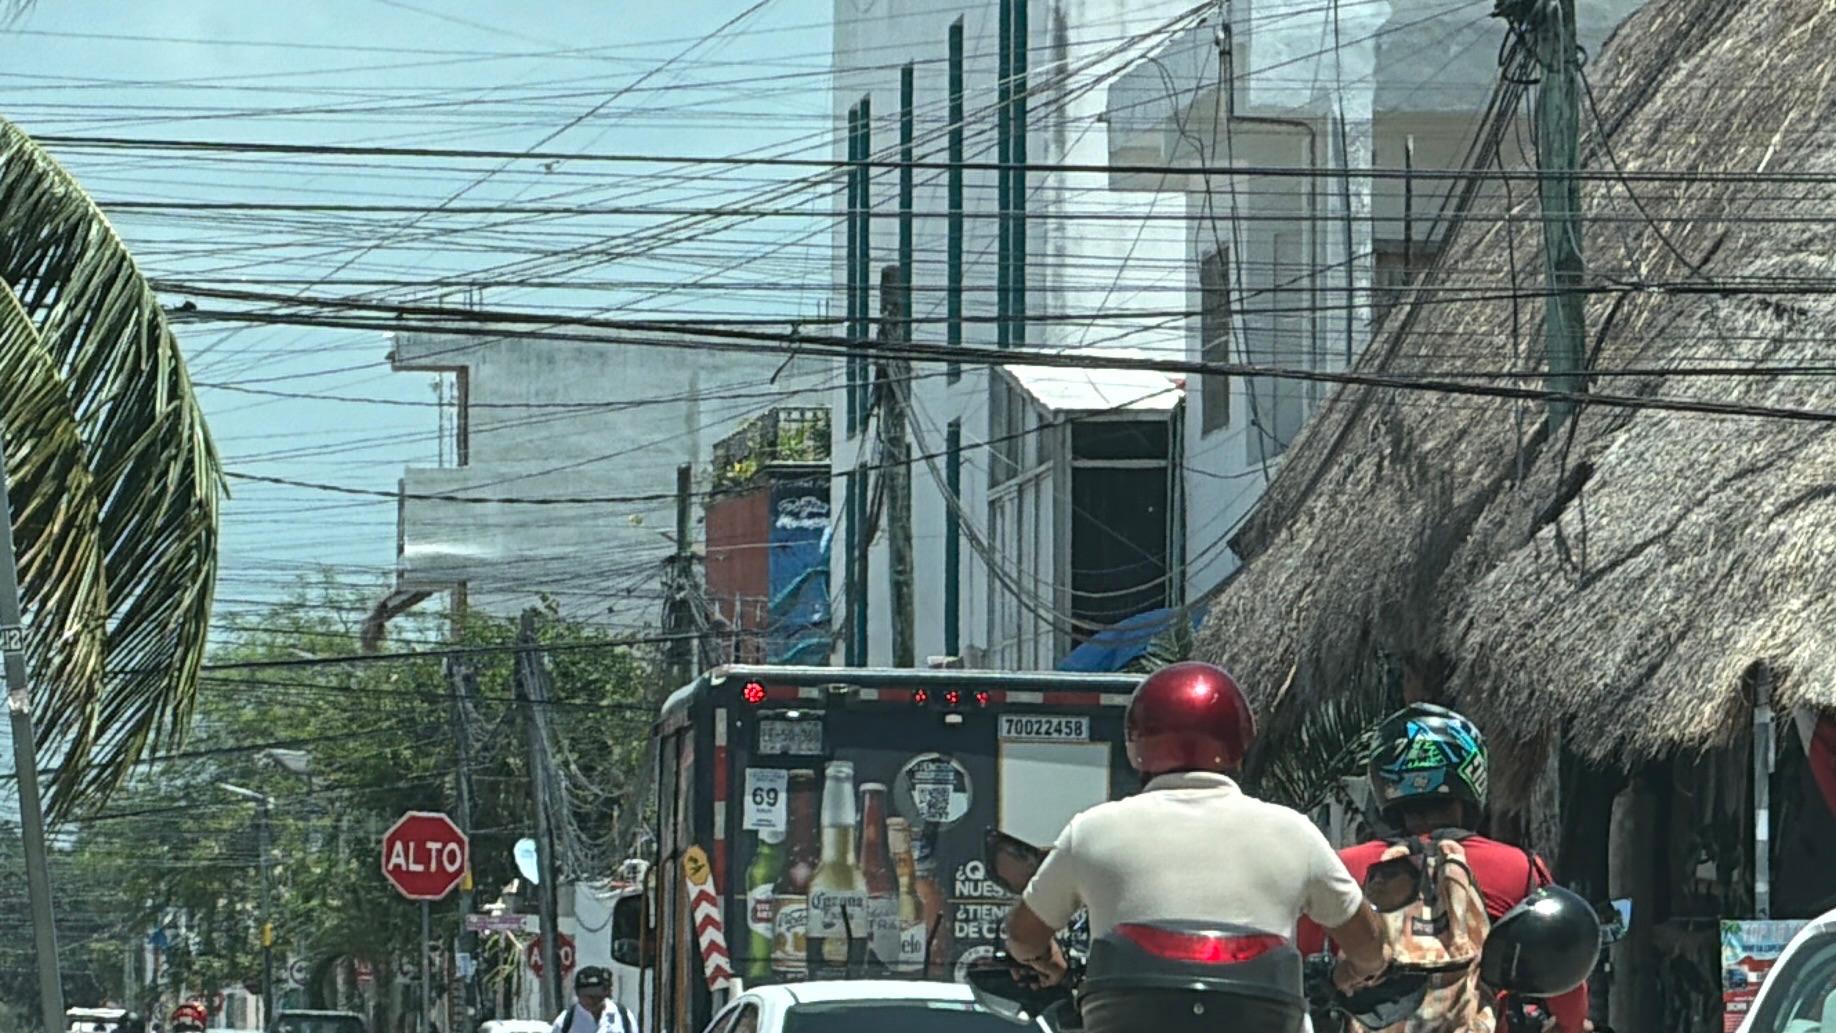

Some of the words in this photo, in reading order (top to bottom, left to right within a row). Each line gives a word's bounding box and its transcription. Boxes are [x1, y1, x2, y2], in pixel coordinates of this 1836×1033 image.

[1006, 719, 1083, 737] 70022458
[752, 787, 779, 808] 69
[387, 840, 462, 874] ALTO
[955, 922, 979, 938] DE
[530, 946, 573, 966] AO
